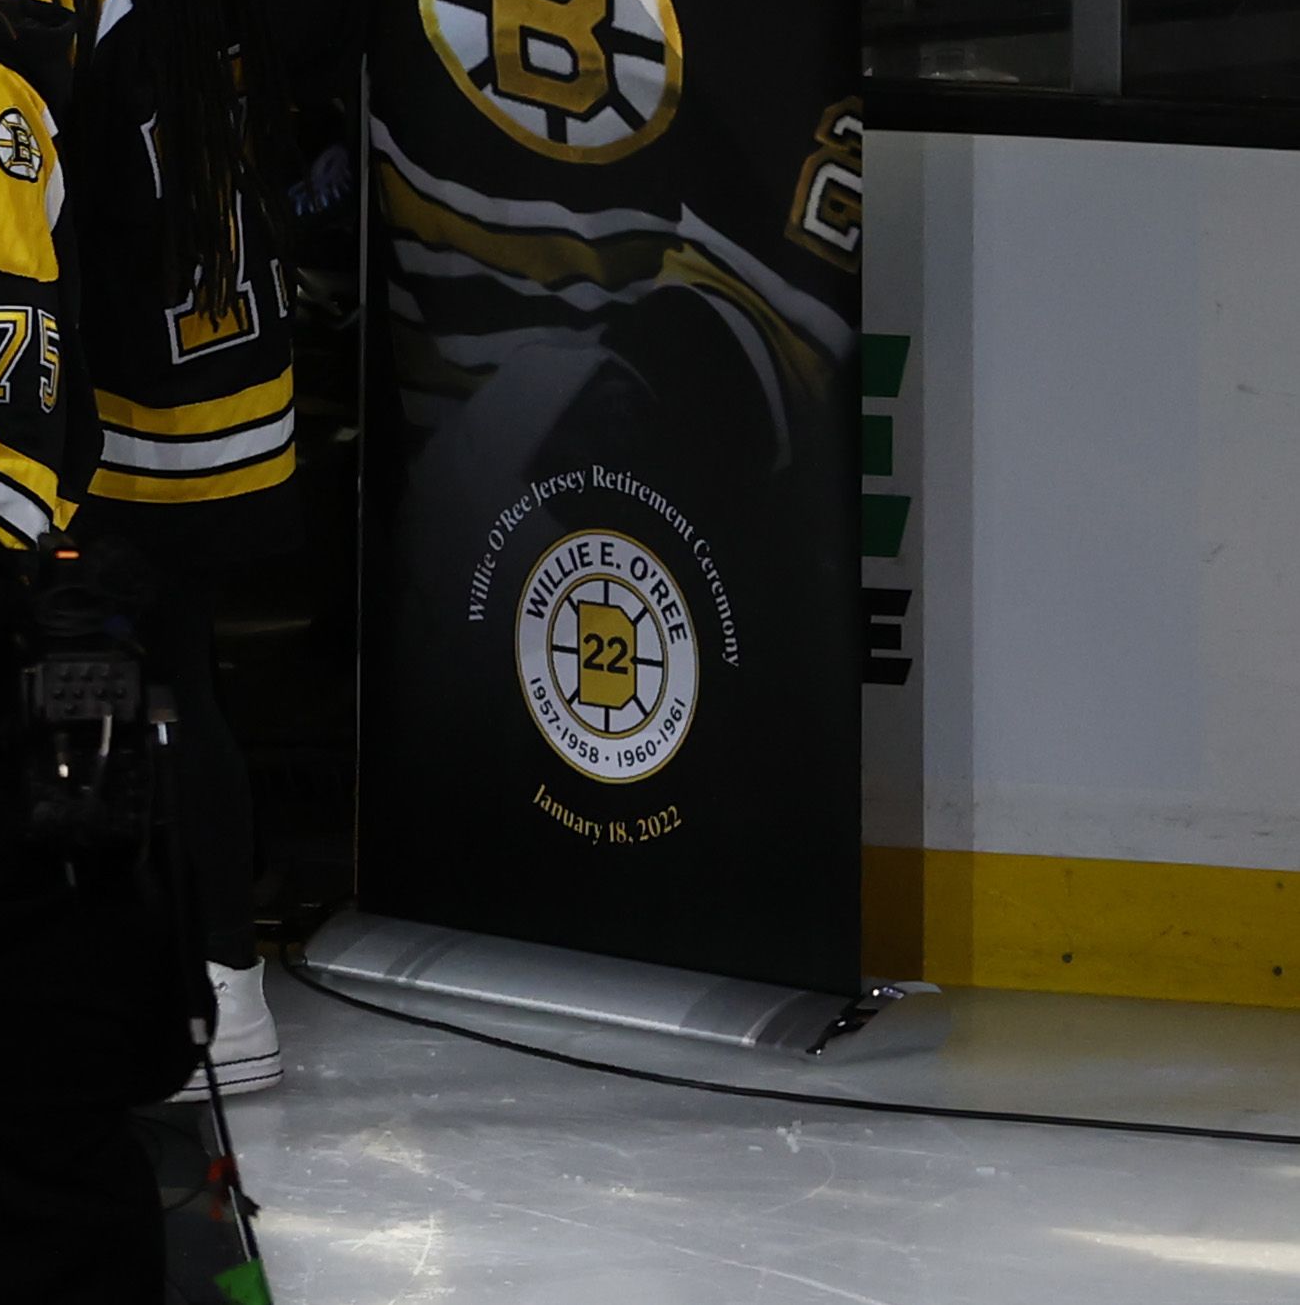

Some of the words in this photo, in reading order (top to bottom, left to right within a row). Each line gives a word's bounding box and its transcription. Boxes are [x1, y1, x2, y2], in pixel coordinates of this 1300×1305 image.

[468, 553, 497, 624] Willie
[531, 469, 587, 507] Jersey
[592, 464, 695, 543] Retirement
[693, 538, 740, 668] Ceremony
[526, 542, 594, 620] WILLIE
[600, 542, 622, 570] E.
[630, 555, 688, 644] O'REE
[583, 633, 629, 676] 22
[529, 677, 600, 764] 1957-1958
[617, 698, 686, 768] 1960-1961
[532, 783, 603, 845] January
[636, 805, 682, 841] 2022
